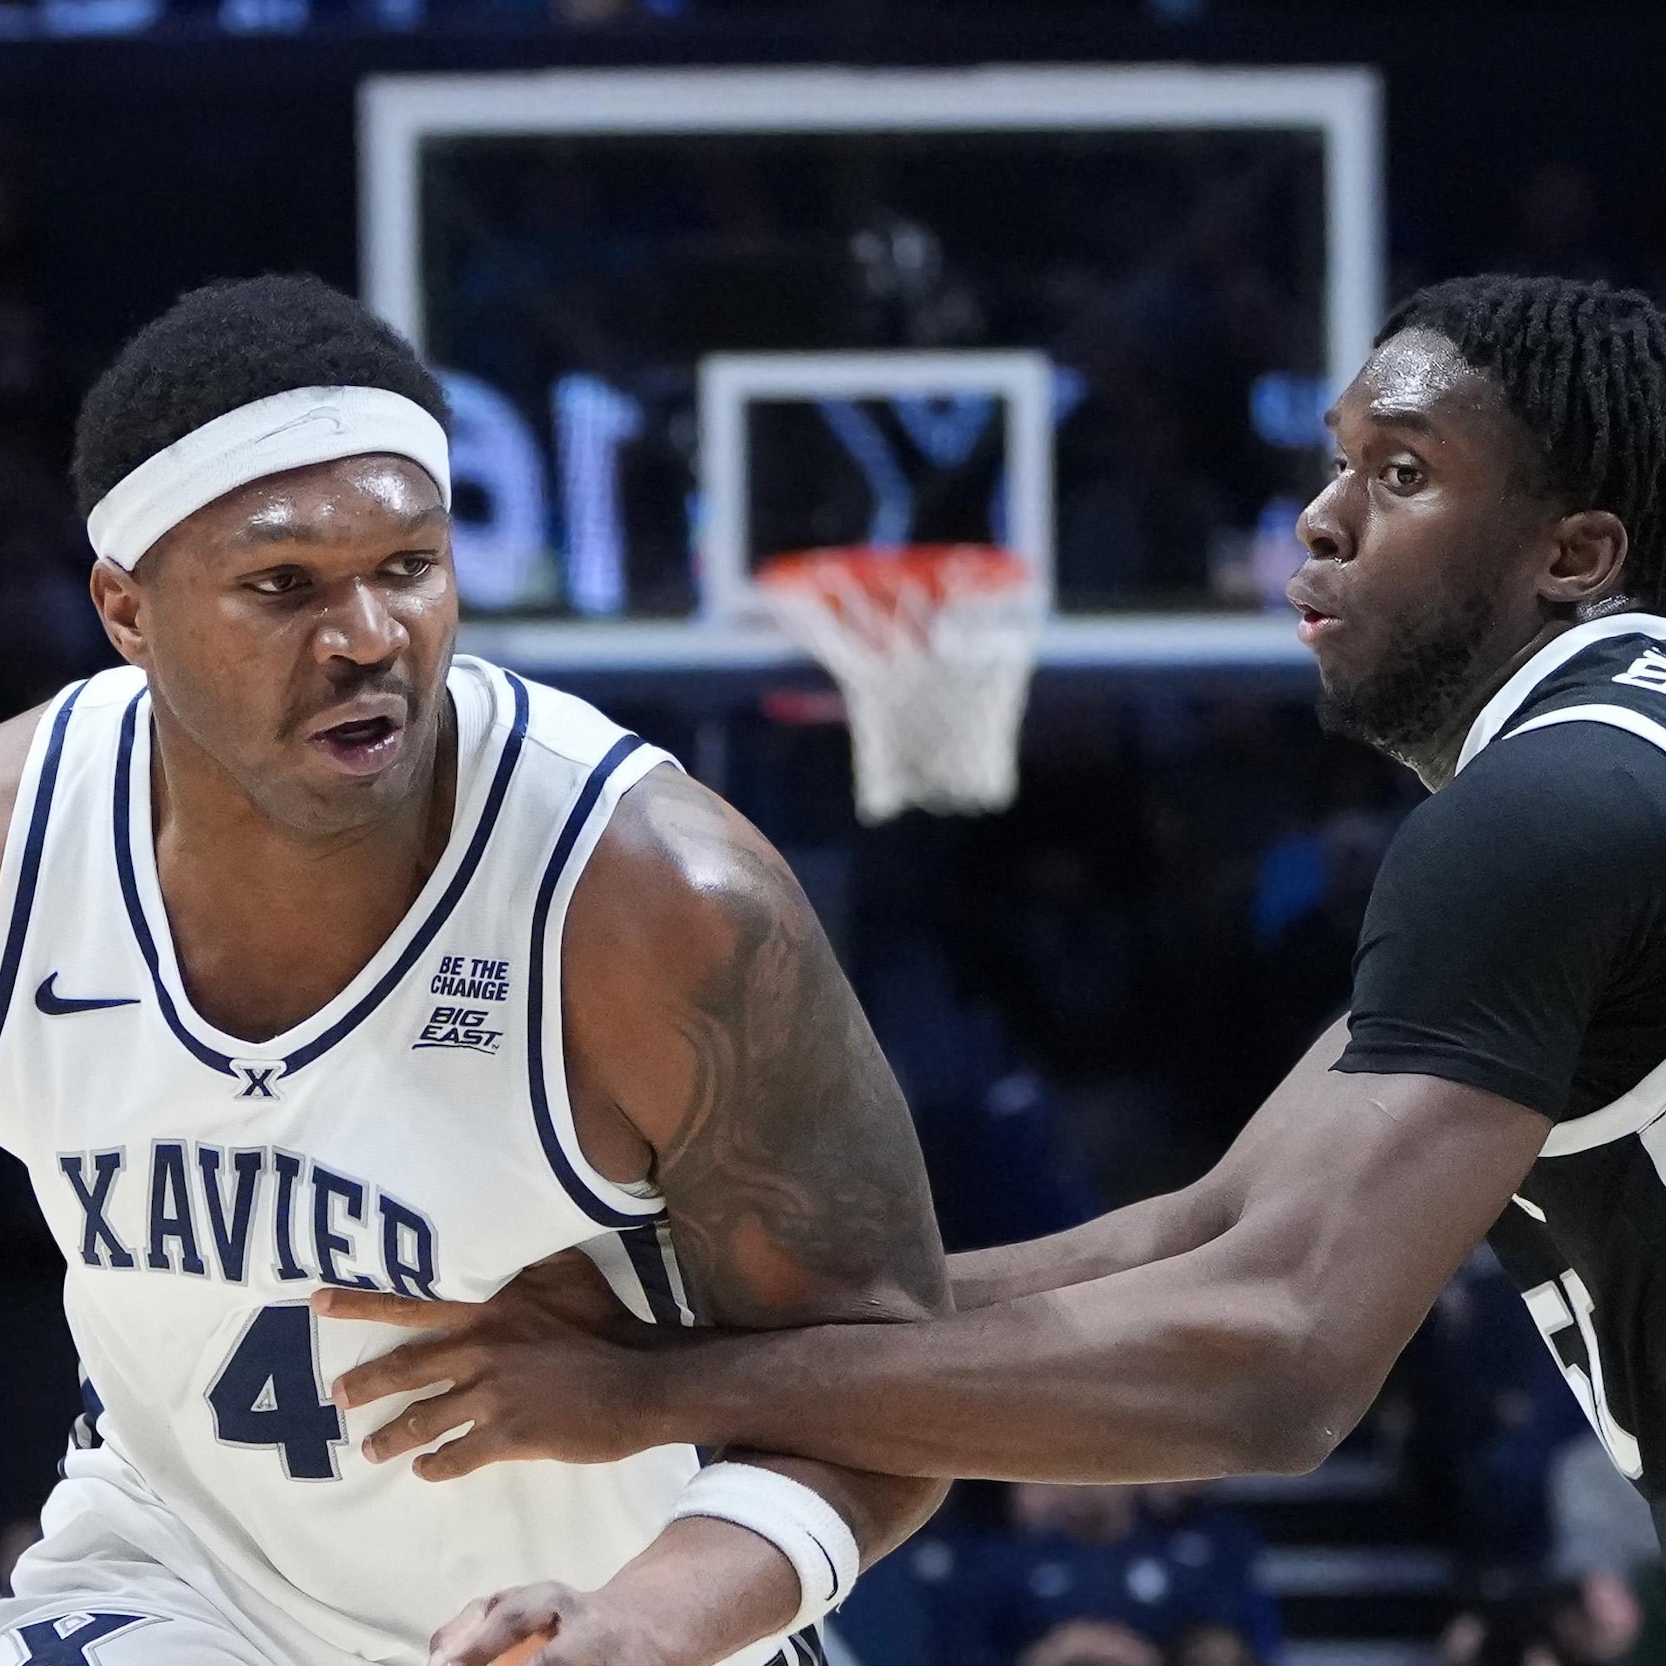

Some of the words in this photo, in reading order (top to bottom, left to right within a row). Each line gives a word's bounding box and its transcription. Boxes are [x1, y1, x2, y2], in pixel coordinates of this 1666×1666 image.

[439, 956, 465, 976] BE
[470, 959, 510, 980] THE
[430, 975, 510, 1001] CHANGE
[429, 1007, 489, 1027] BIG
[419, 1025, 503, 1046] EAST
[237, 1066, 279, 1099] X
[57, 1138, 441, 1302] XAVIER
[204, 1299, 350, 1483] 4
